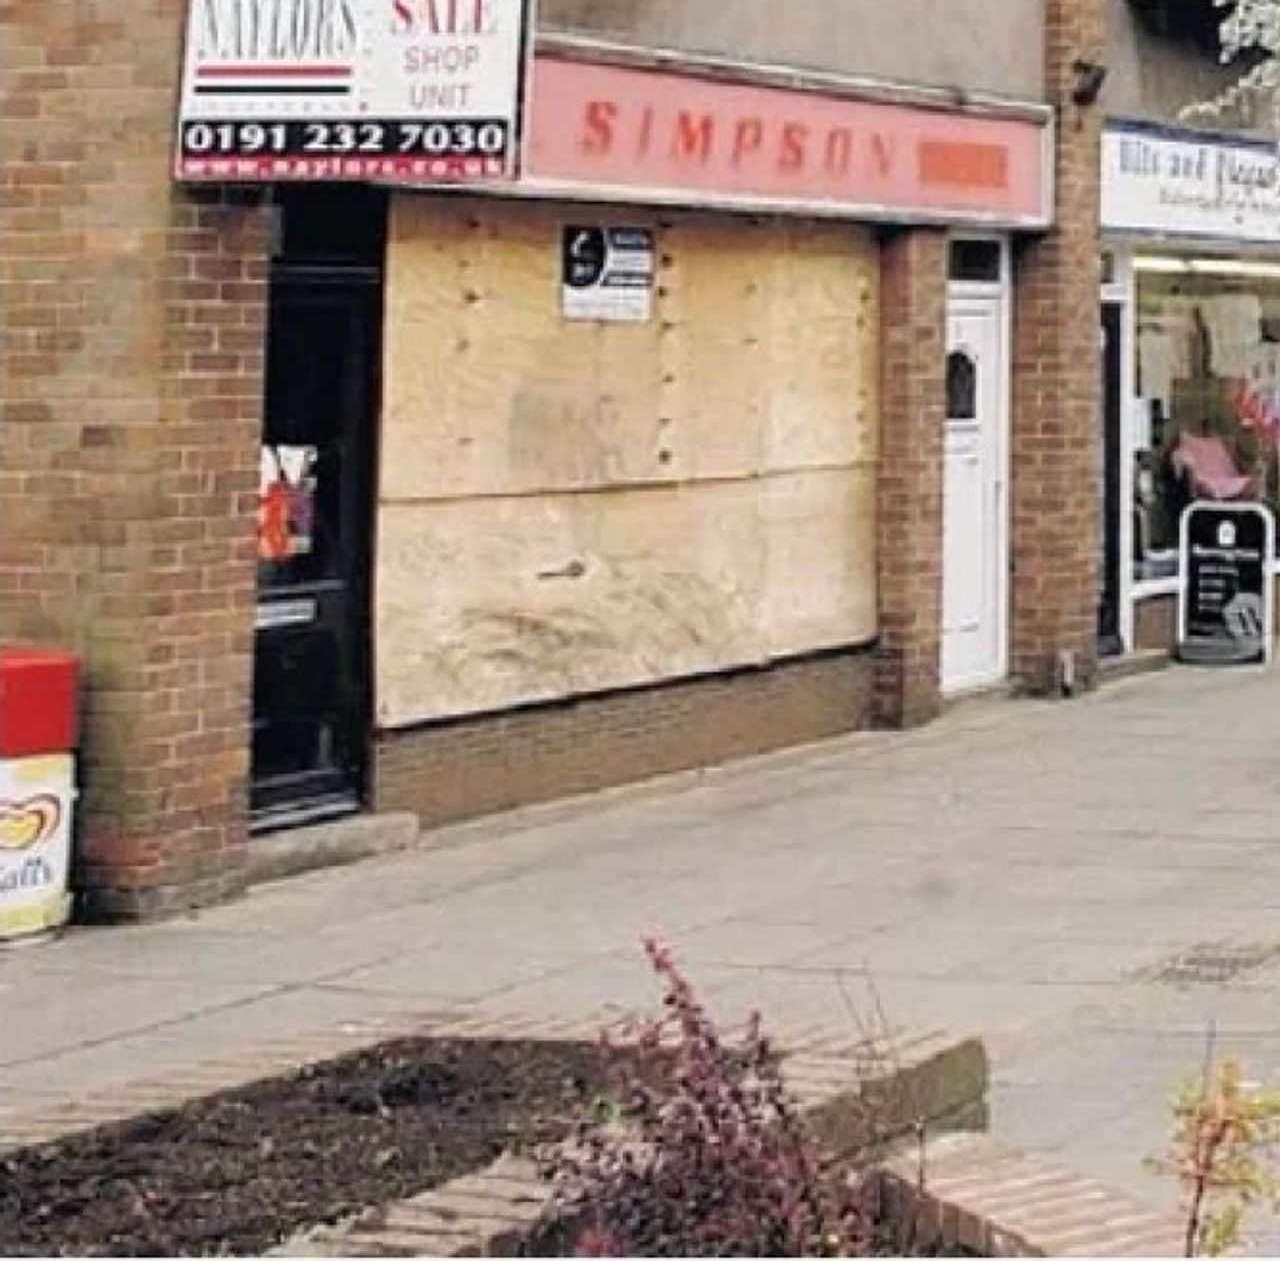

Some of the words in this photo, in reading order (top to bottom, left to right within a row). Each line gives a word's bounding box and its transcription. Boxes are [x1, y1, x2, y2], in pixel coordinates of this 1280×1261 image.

[403, 45, 480, 75] SHOP
[408, 84, 470, 109] UNIT
[184, 124, 288, 152] 0191
[303, 124, 385, 152] 232
[400, 124, 504, 152] 7030
[580, 100, 896, 178] SIMPSON
